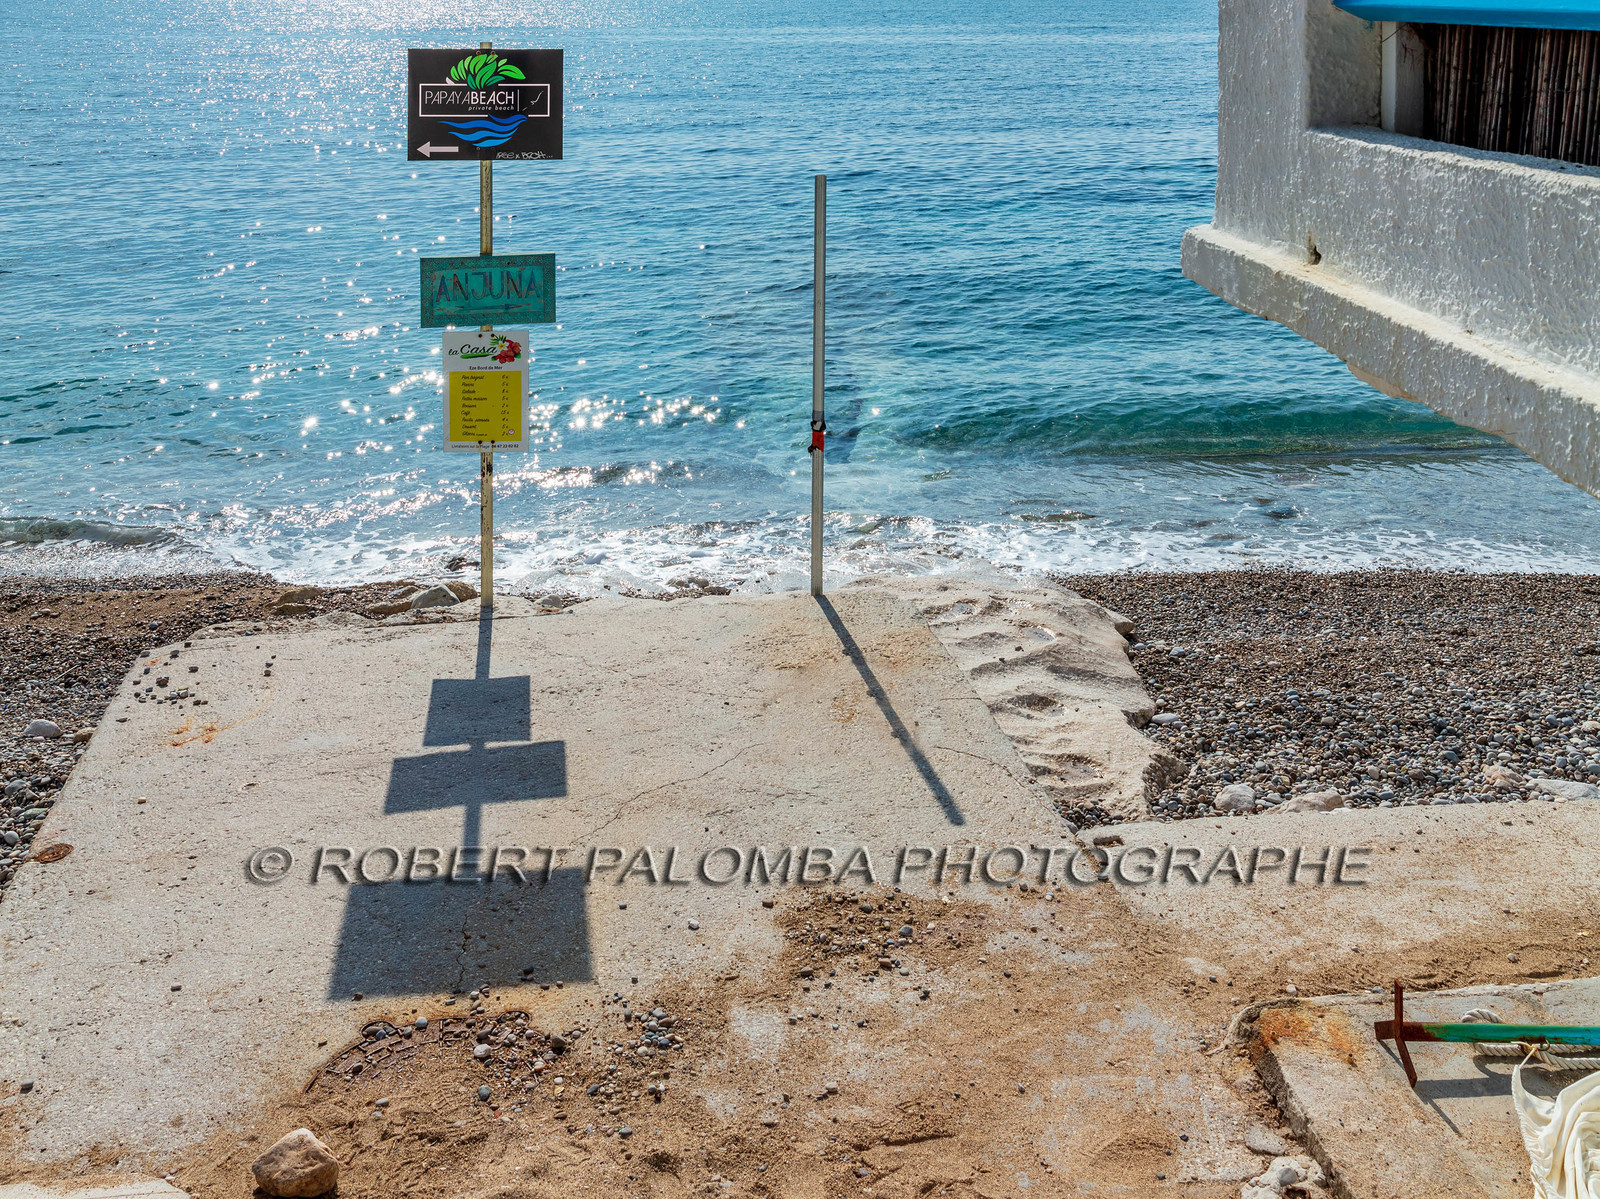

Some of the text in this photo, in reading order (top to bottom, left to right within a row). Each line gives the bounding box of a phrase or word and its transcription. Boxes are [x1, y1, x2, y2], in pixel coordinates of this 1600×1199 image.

[435, 270, 541, 302] ANJUNA
[448, 343, 498, 356] la Casa
